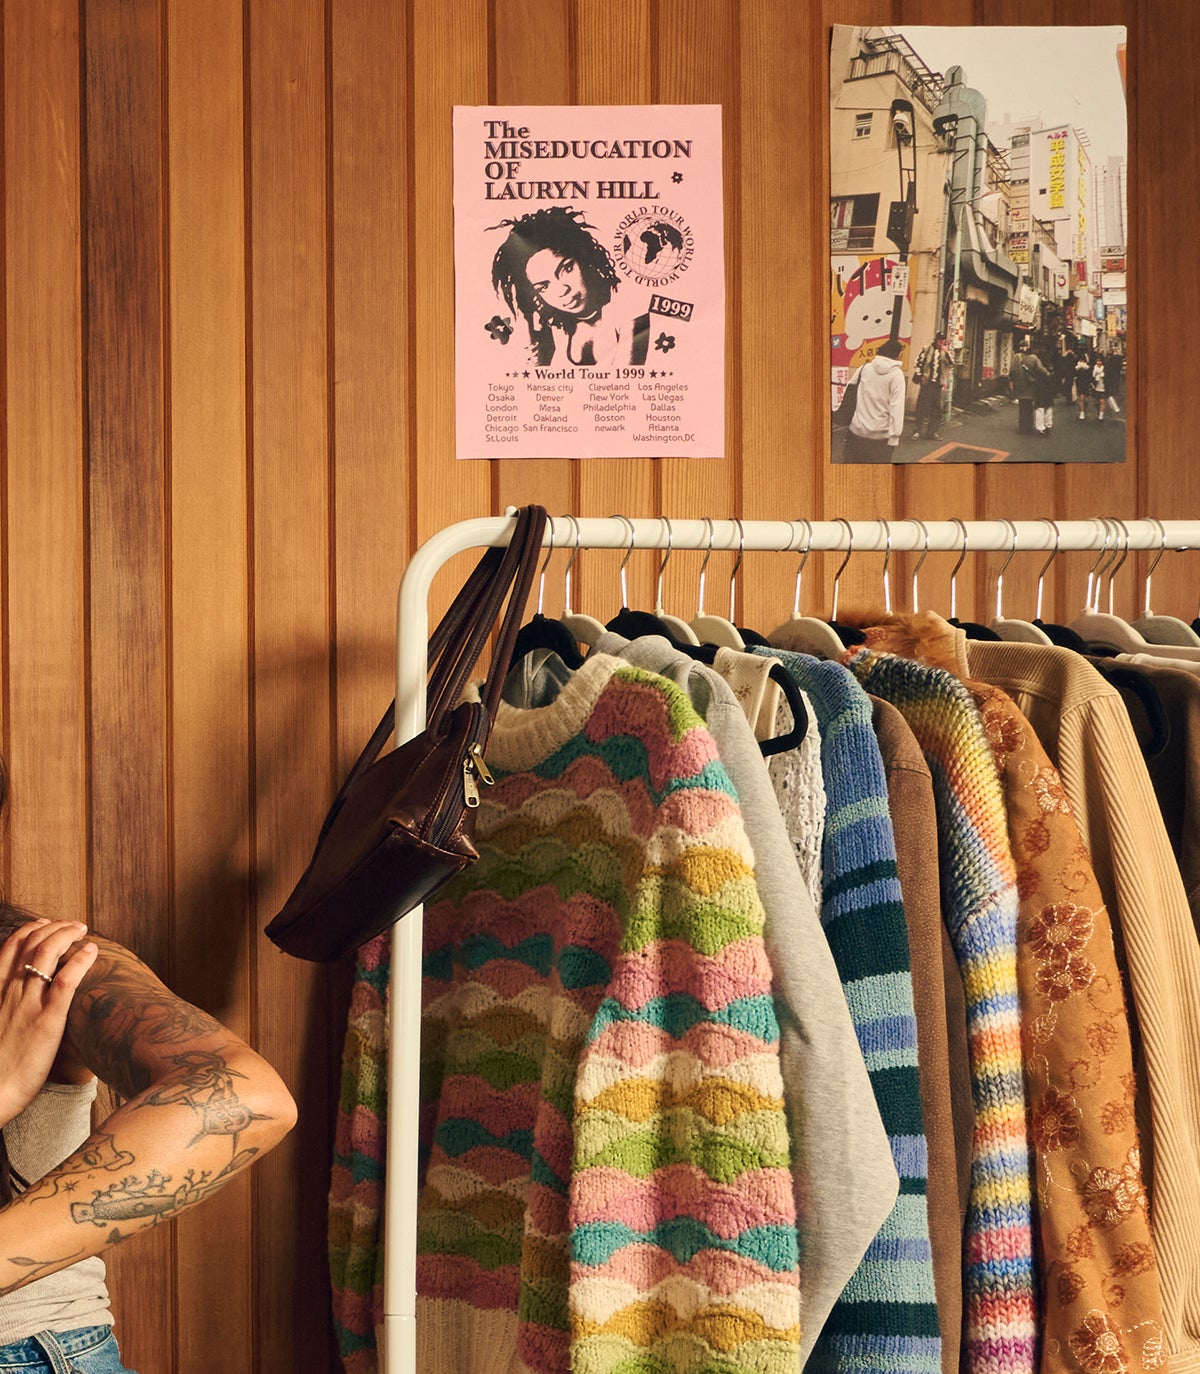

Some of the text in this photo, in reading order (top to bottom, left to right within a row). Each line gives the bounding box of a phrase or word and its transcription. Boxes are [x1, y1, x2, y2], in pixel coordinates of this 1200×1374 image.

[483, 120, 530, 139] The
[484, 140, 693, 159] MISEDUCATION
[484, 161, 521, 180] OF
[484, 180, 660, 200] LAURYN HILL
[614, 205, 685, 239] WORLD TOUR
[679, 226, 695, 272] WORLD
[613, 244, 633, 278] TOUR
[634, 272, 680, 288] WORLD
[651, 296, 691, 318] 1999
[535, 368, 645, 380] World Tour 1999
[488, 383, 515, 393] Tokyo
[526, 383, 574, 393] Kansas city
[588, 383, 630, 391] Cleveland
[637, 382, 689, 393] Los Angeles
[487, 393, 515, 402] Osaka
[535, 393, 564, 402] Denver
[609, 393, 630, 401] York
[642, 393, 685, 403] Las Vegas
[485, 404, 518, 412] London
[539, 404, 561, 412] Mesa
[583, 403, 637, 413] Philadelphia
[650, 403, 676, 411] Dallas
[486, 414, 517, 422] Detroit
[533, 413, 568, 423] Oakland
[594, 413, 626, 422] Boston
[645, 413, 681, 422] Houston
[484, 424, 520, 434] Chicago
[522, 424, 538, 432] San
[648, 423, 680, 432] Atlanta
